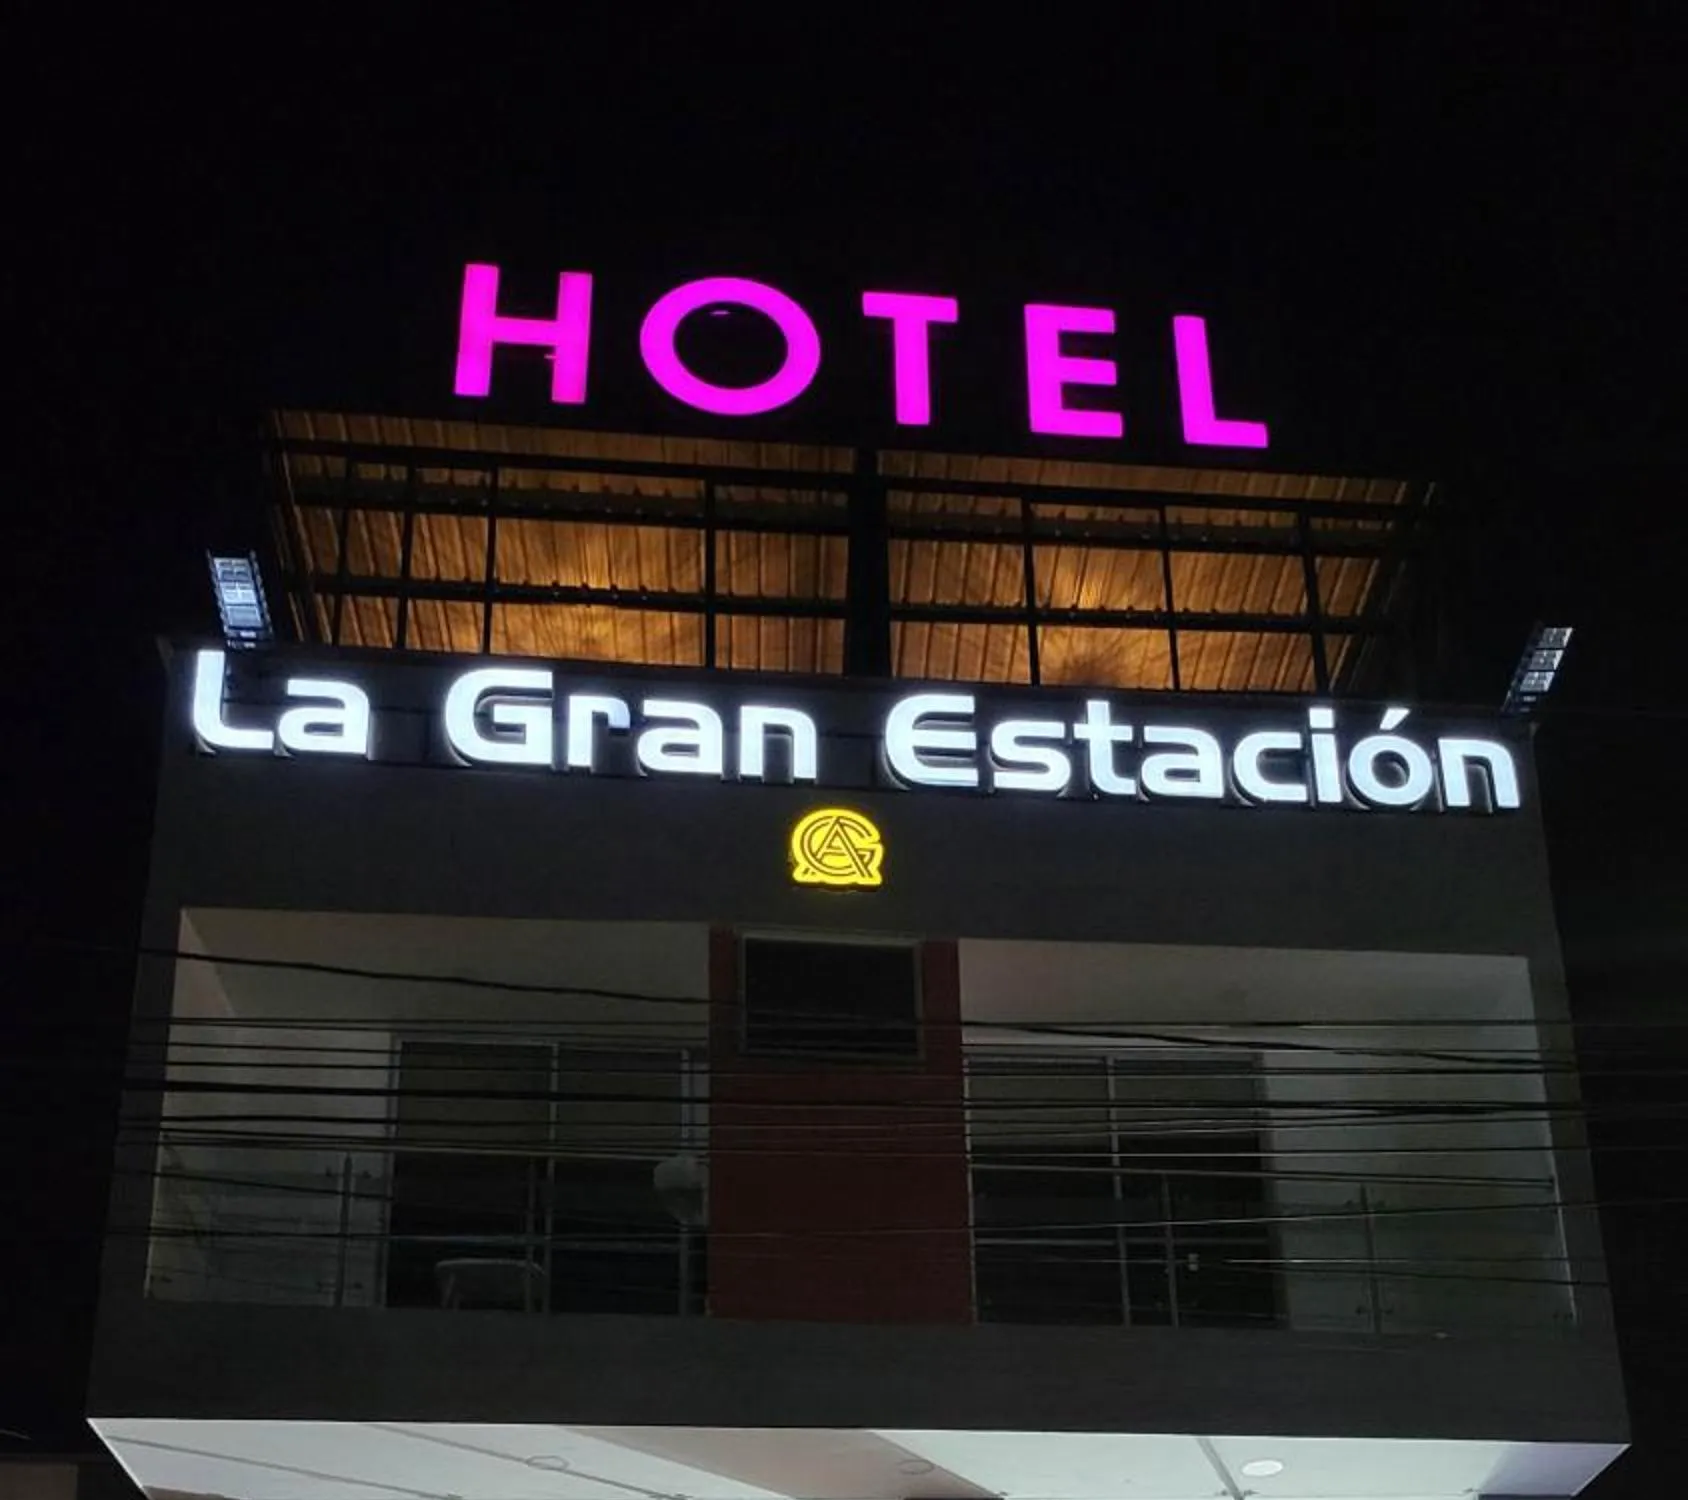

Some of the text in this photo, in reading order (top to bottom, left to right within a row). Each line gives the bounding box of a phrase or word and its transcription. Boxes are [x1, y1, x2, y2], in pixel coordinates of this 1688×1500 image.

[455, 264, 1269, 448] HOTEL
[192, 650, 1521, 808] La Gran Estación
